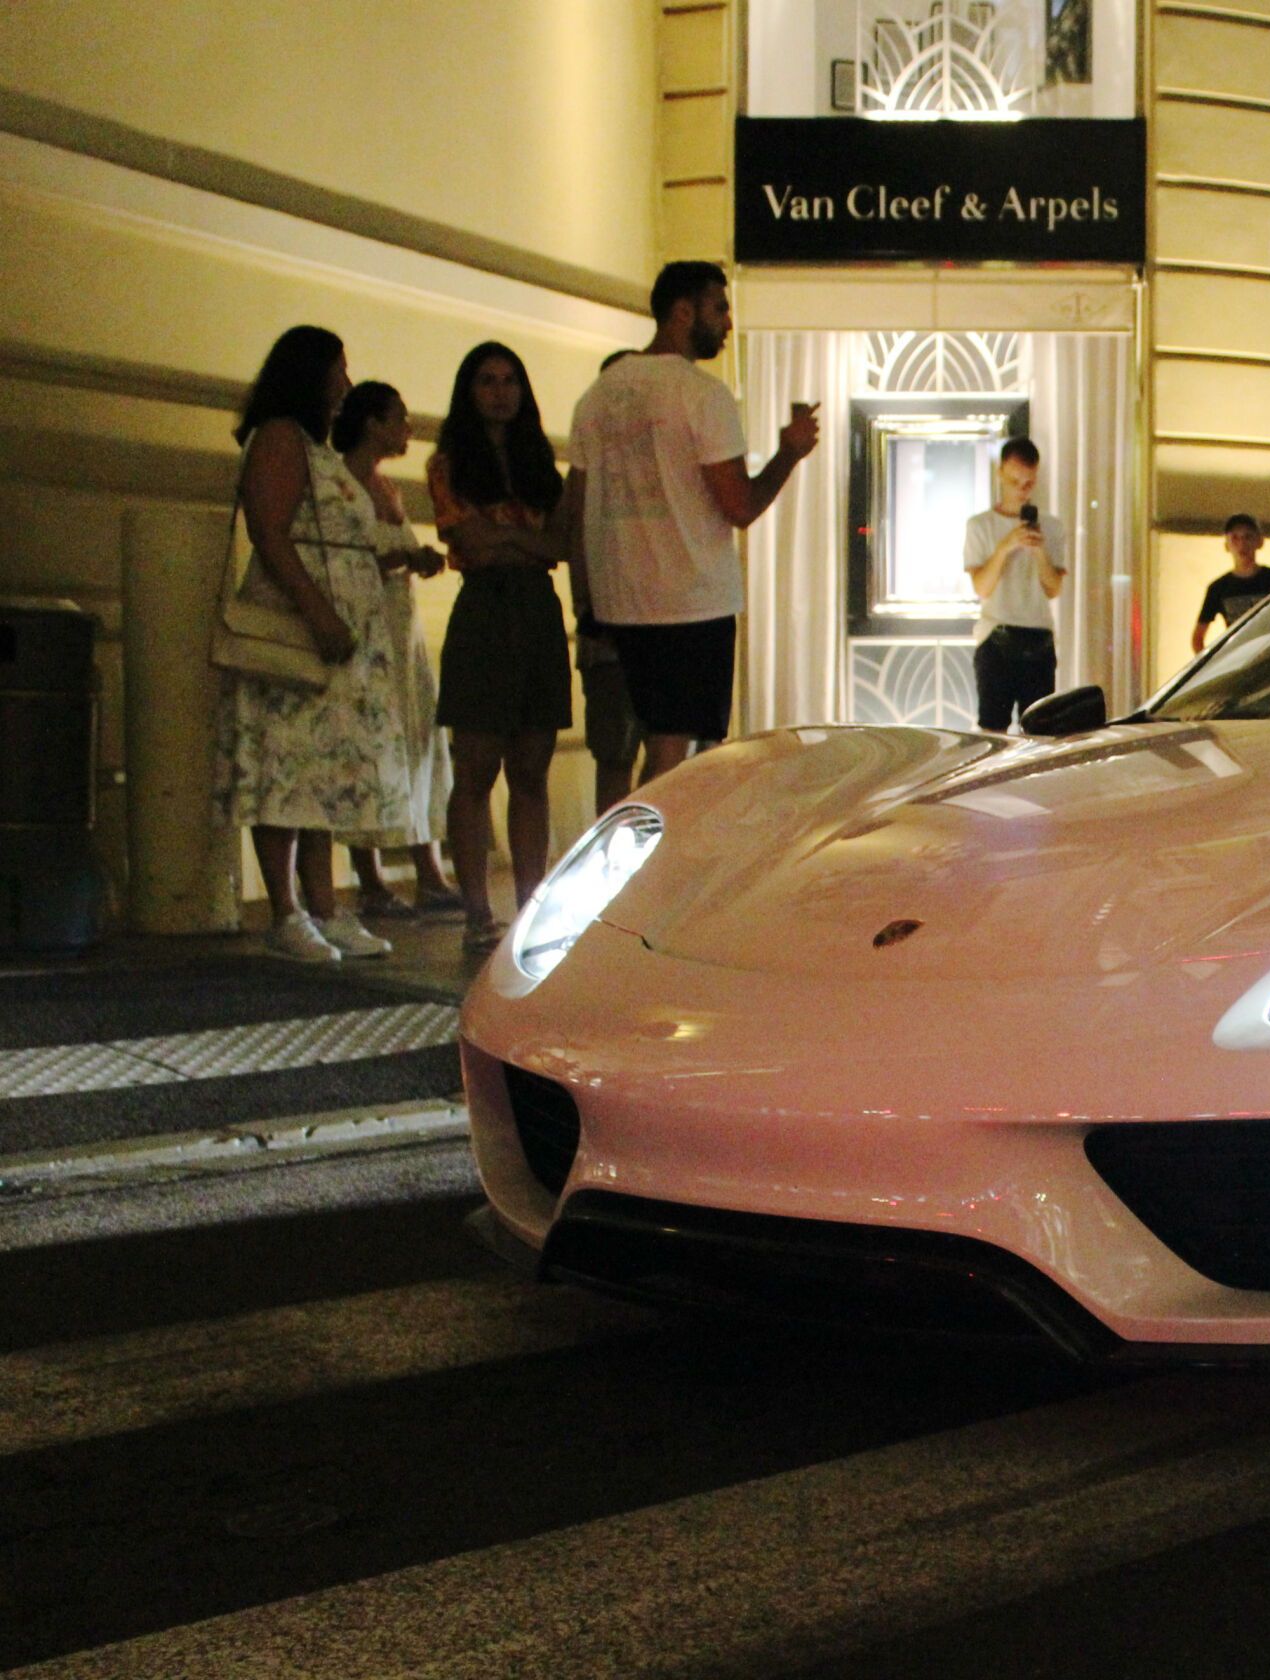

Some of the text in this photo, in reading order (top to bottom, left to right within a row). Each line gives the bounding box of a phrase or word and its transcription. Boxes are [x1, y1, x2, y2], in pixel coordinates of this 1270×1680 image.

[762, 184, 1119, 231] Van Cleef & Arpels
